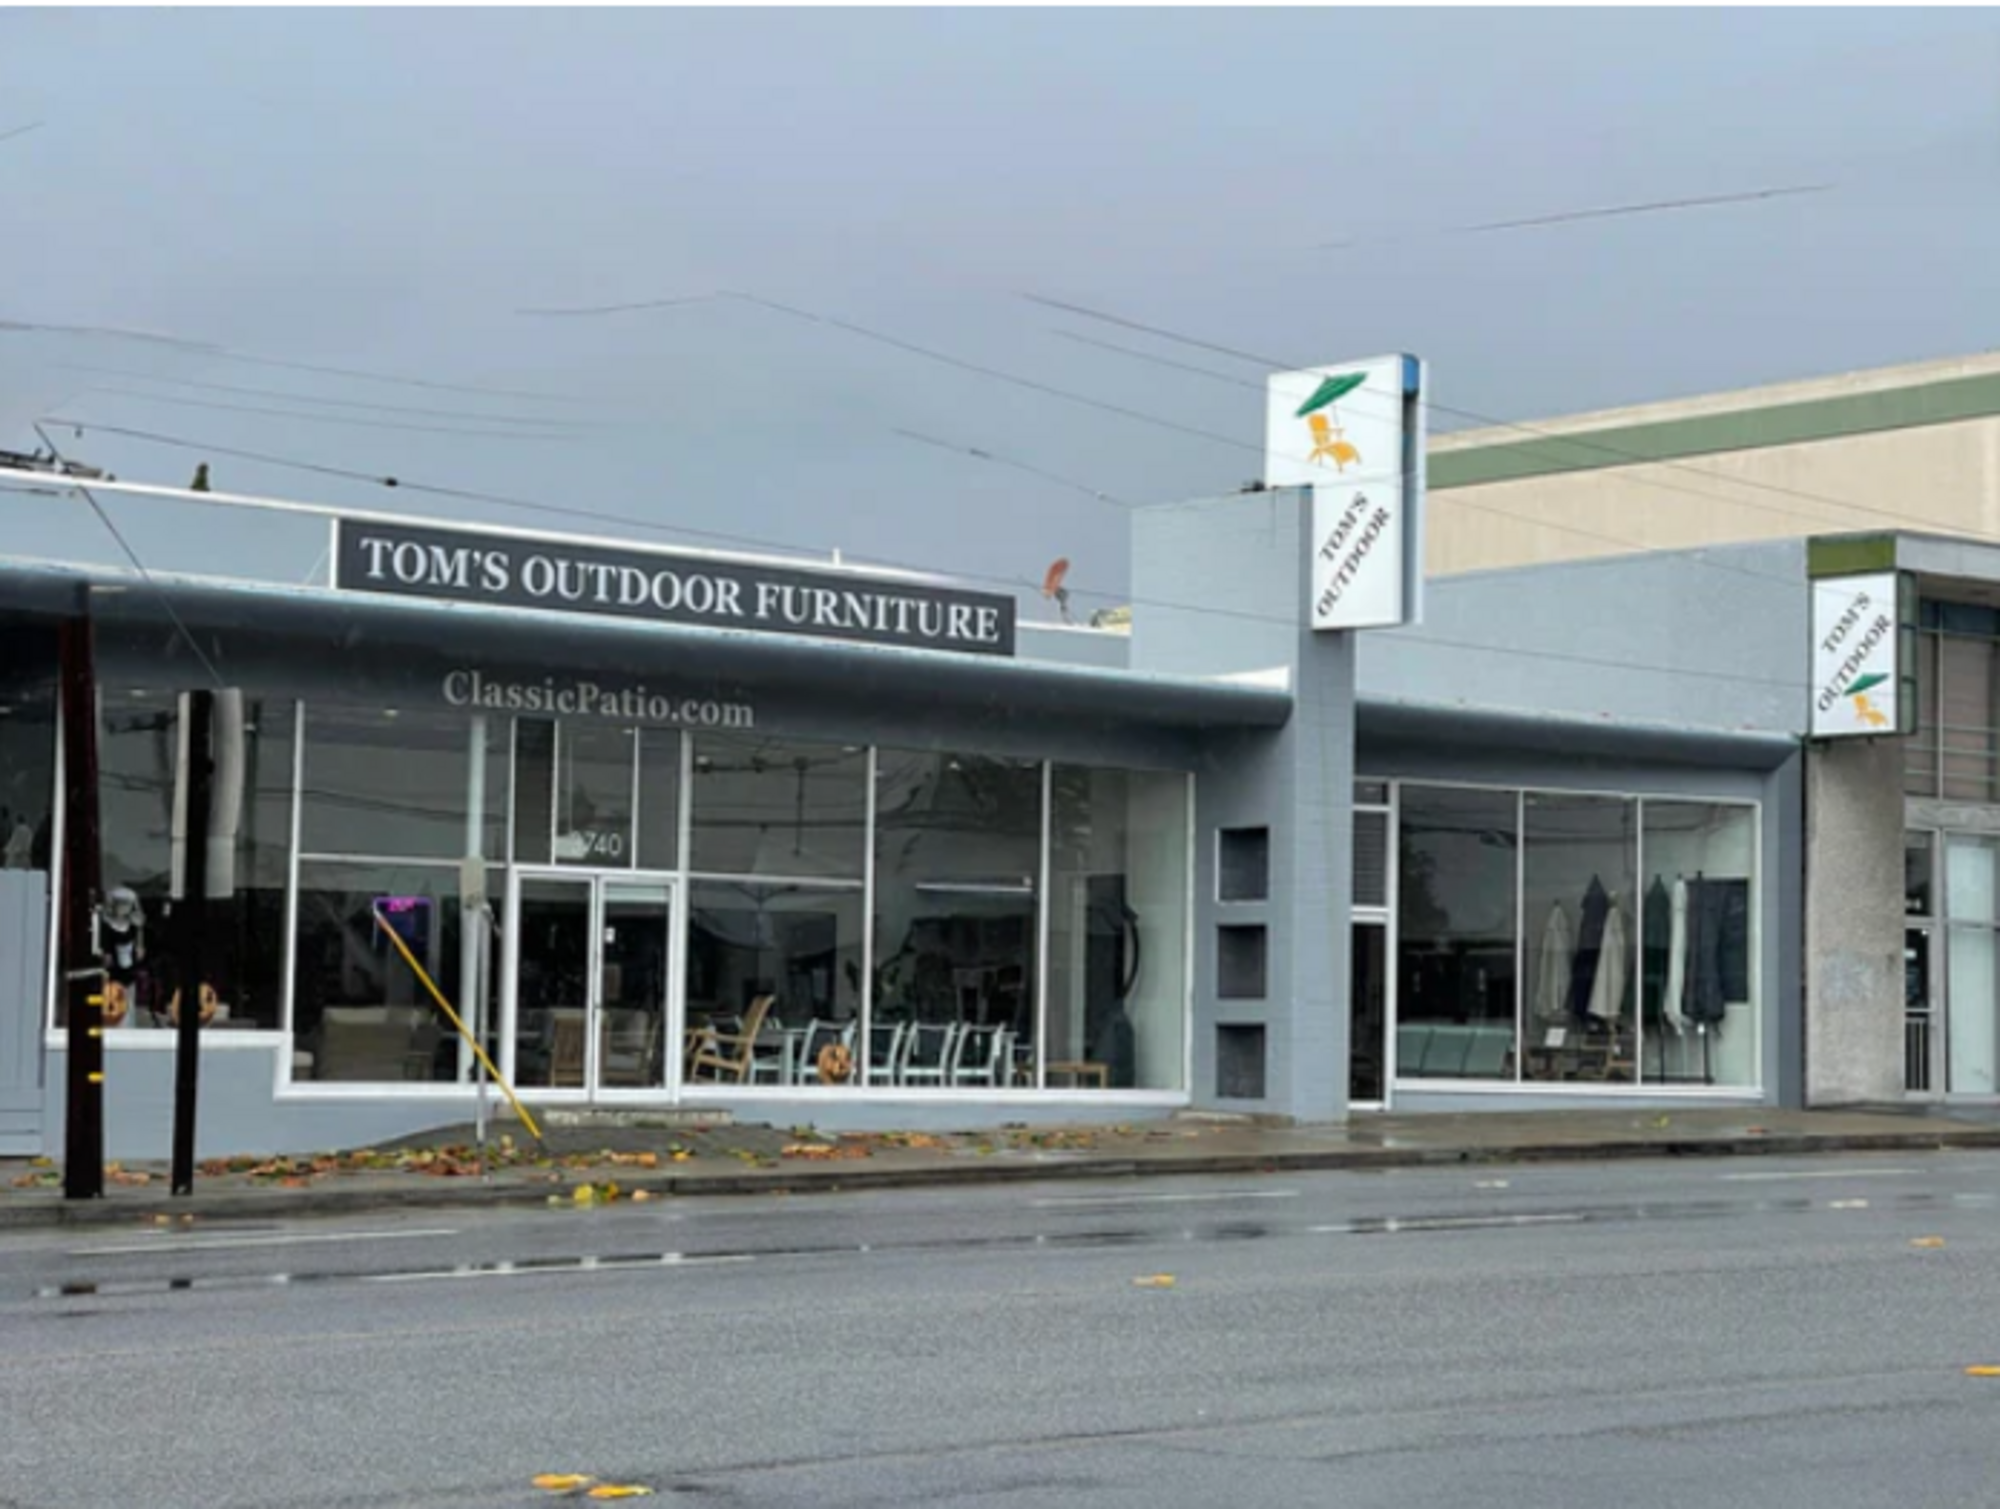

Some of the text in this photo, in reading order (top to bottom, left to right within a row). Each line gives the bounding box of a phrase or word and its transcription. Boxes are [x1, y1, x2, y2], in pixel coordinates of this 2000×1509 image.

[1316, 507, 1391, 618] OUTDOOR
[1319, 491, 1367, 562] TOM'S
[360, 537, 1000, 643] TOM'S OUTDOOR FURNITURE
[1822, 592, 1870, 653] TOM'S
[442, 669, 755, 728] ClassicPatio.com
[1817, 614, 1890, 712] OUTDOOR
